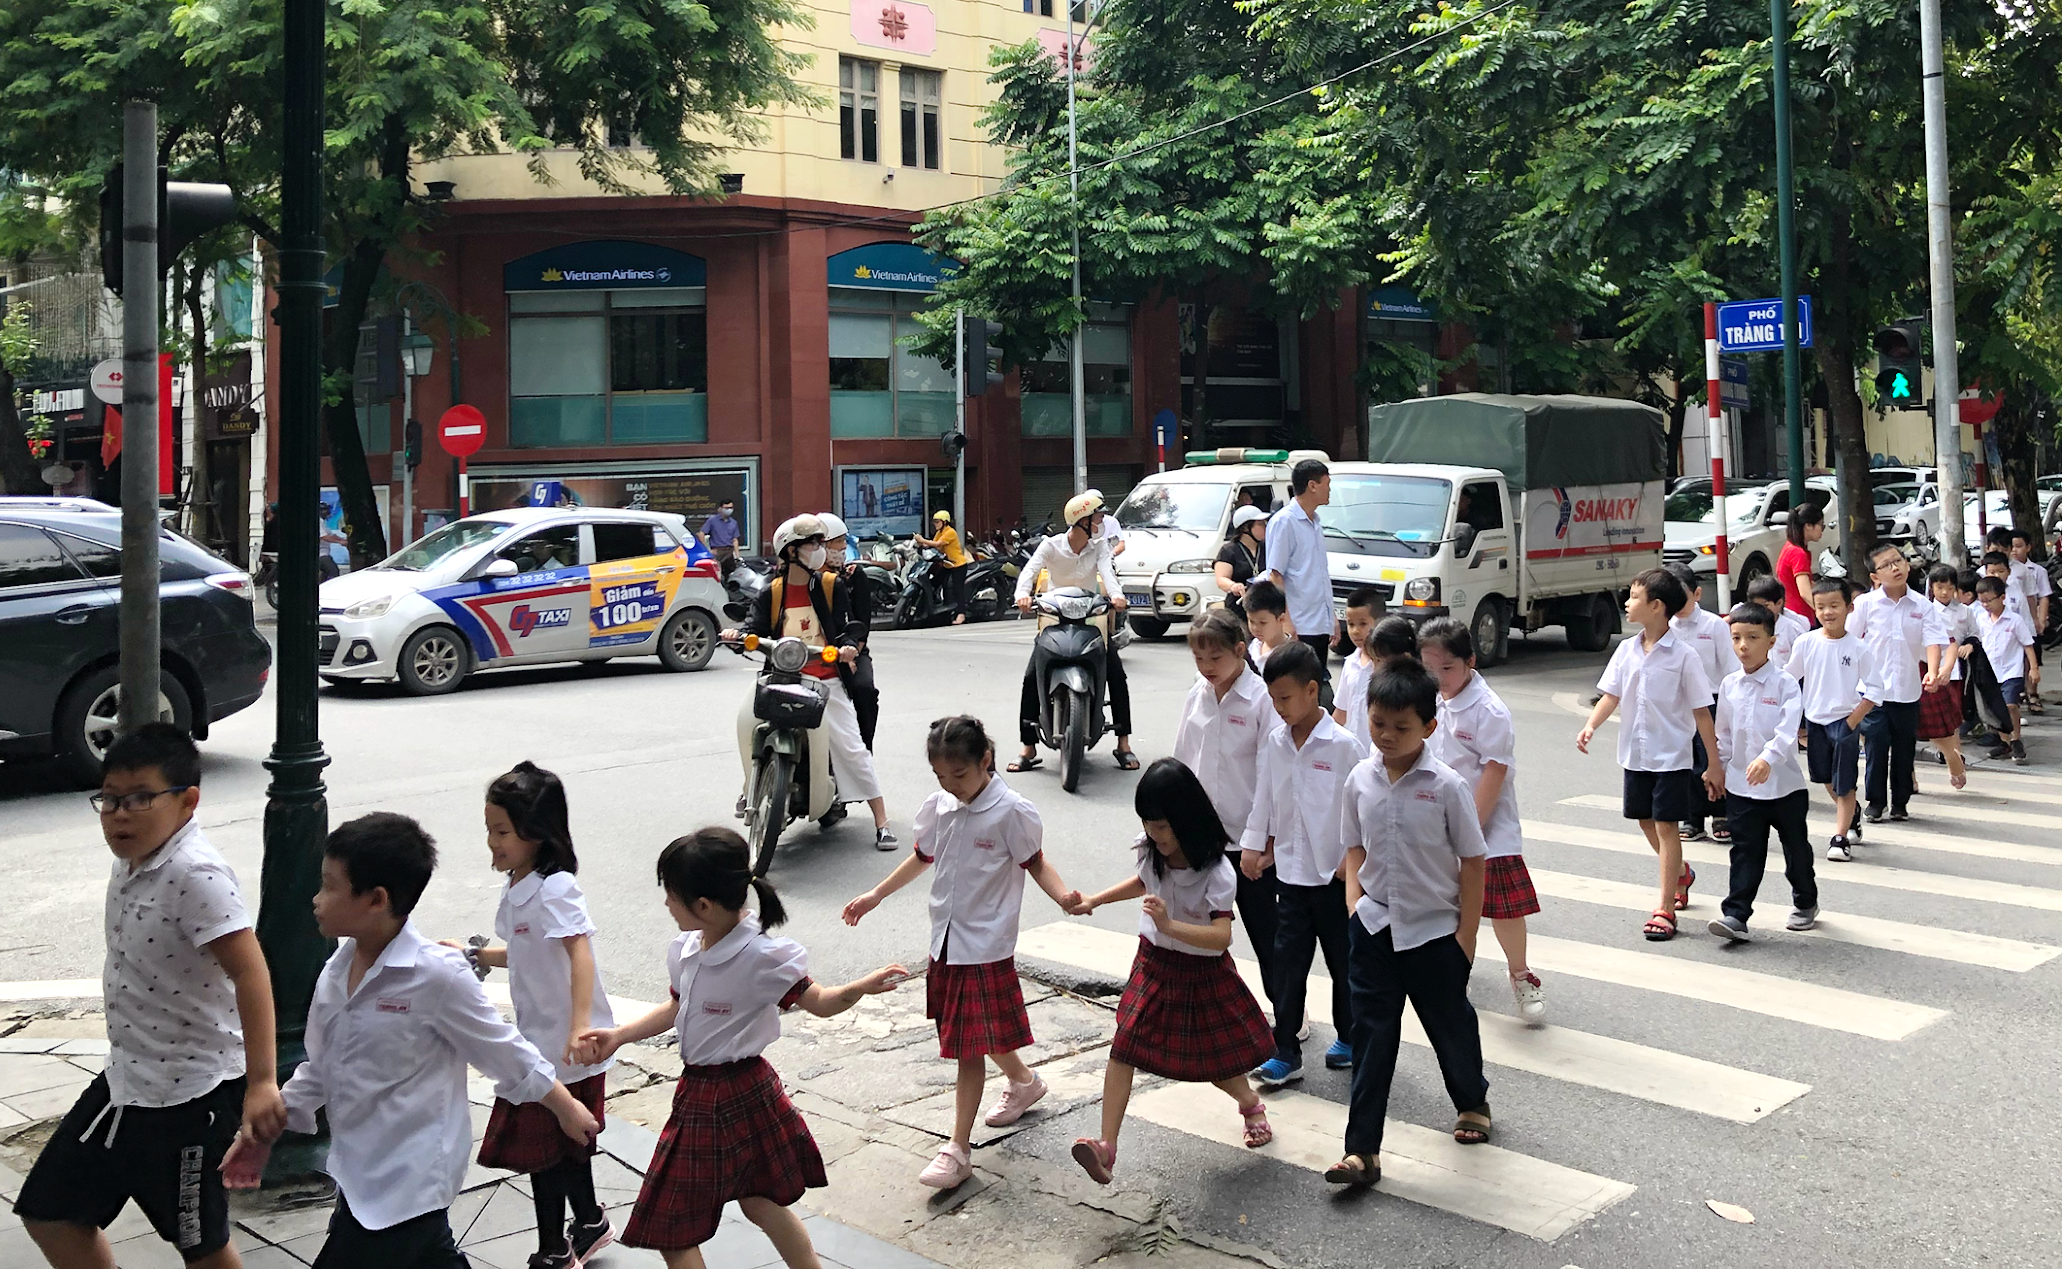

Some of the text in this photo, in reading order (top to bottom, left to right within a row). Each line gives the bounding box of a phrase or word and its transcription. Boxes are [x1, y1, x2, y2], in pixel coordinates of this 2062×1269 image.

[563, 269, 654, 281] Vietnam Airlines
[871, 269, 938, 283] Vietnam Airlines
[1748, 305, 1776, 320] PHỐ
[1725, 322, 1774, 344] TRÀNG
[1573, 497, 1638, 522] SANAKY
[605, 585, 642, 604] Giảm
[538, 609, 571, 624] TAXI
[599, 601, 642, 627] 100
[178, 1145, 204, 1249] CHAMPION
